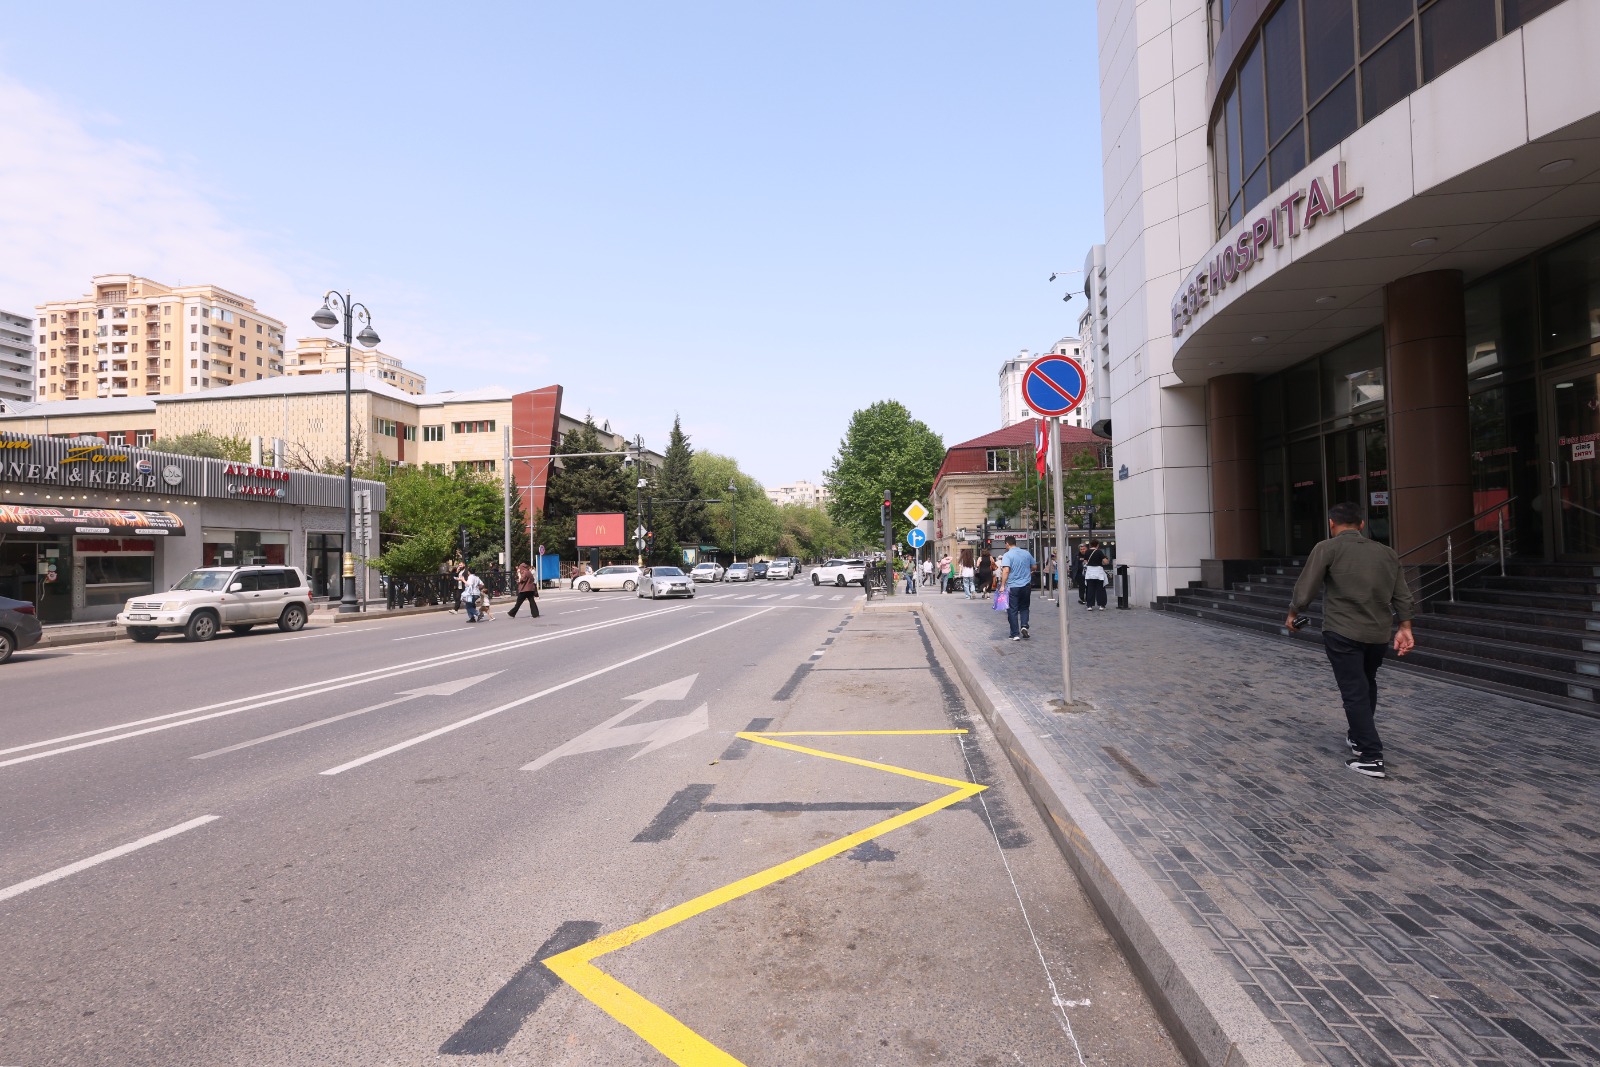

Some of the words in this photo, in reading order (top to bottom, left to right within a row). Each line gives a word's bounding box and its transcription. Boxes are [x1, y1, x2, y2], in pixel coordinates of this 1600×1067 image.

[1208, 160, 1364, 296] HOSPITAL
[1574, 450, 1593, 458] ENTRY
[68, 467, 83, 482] &
[88, 469, 157, 488] KEBAB
[224, 464, 244, 477] AL
